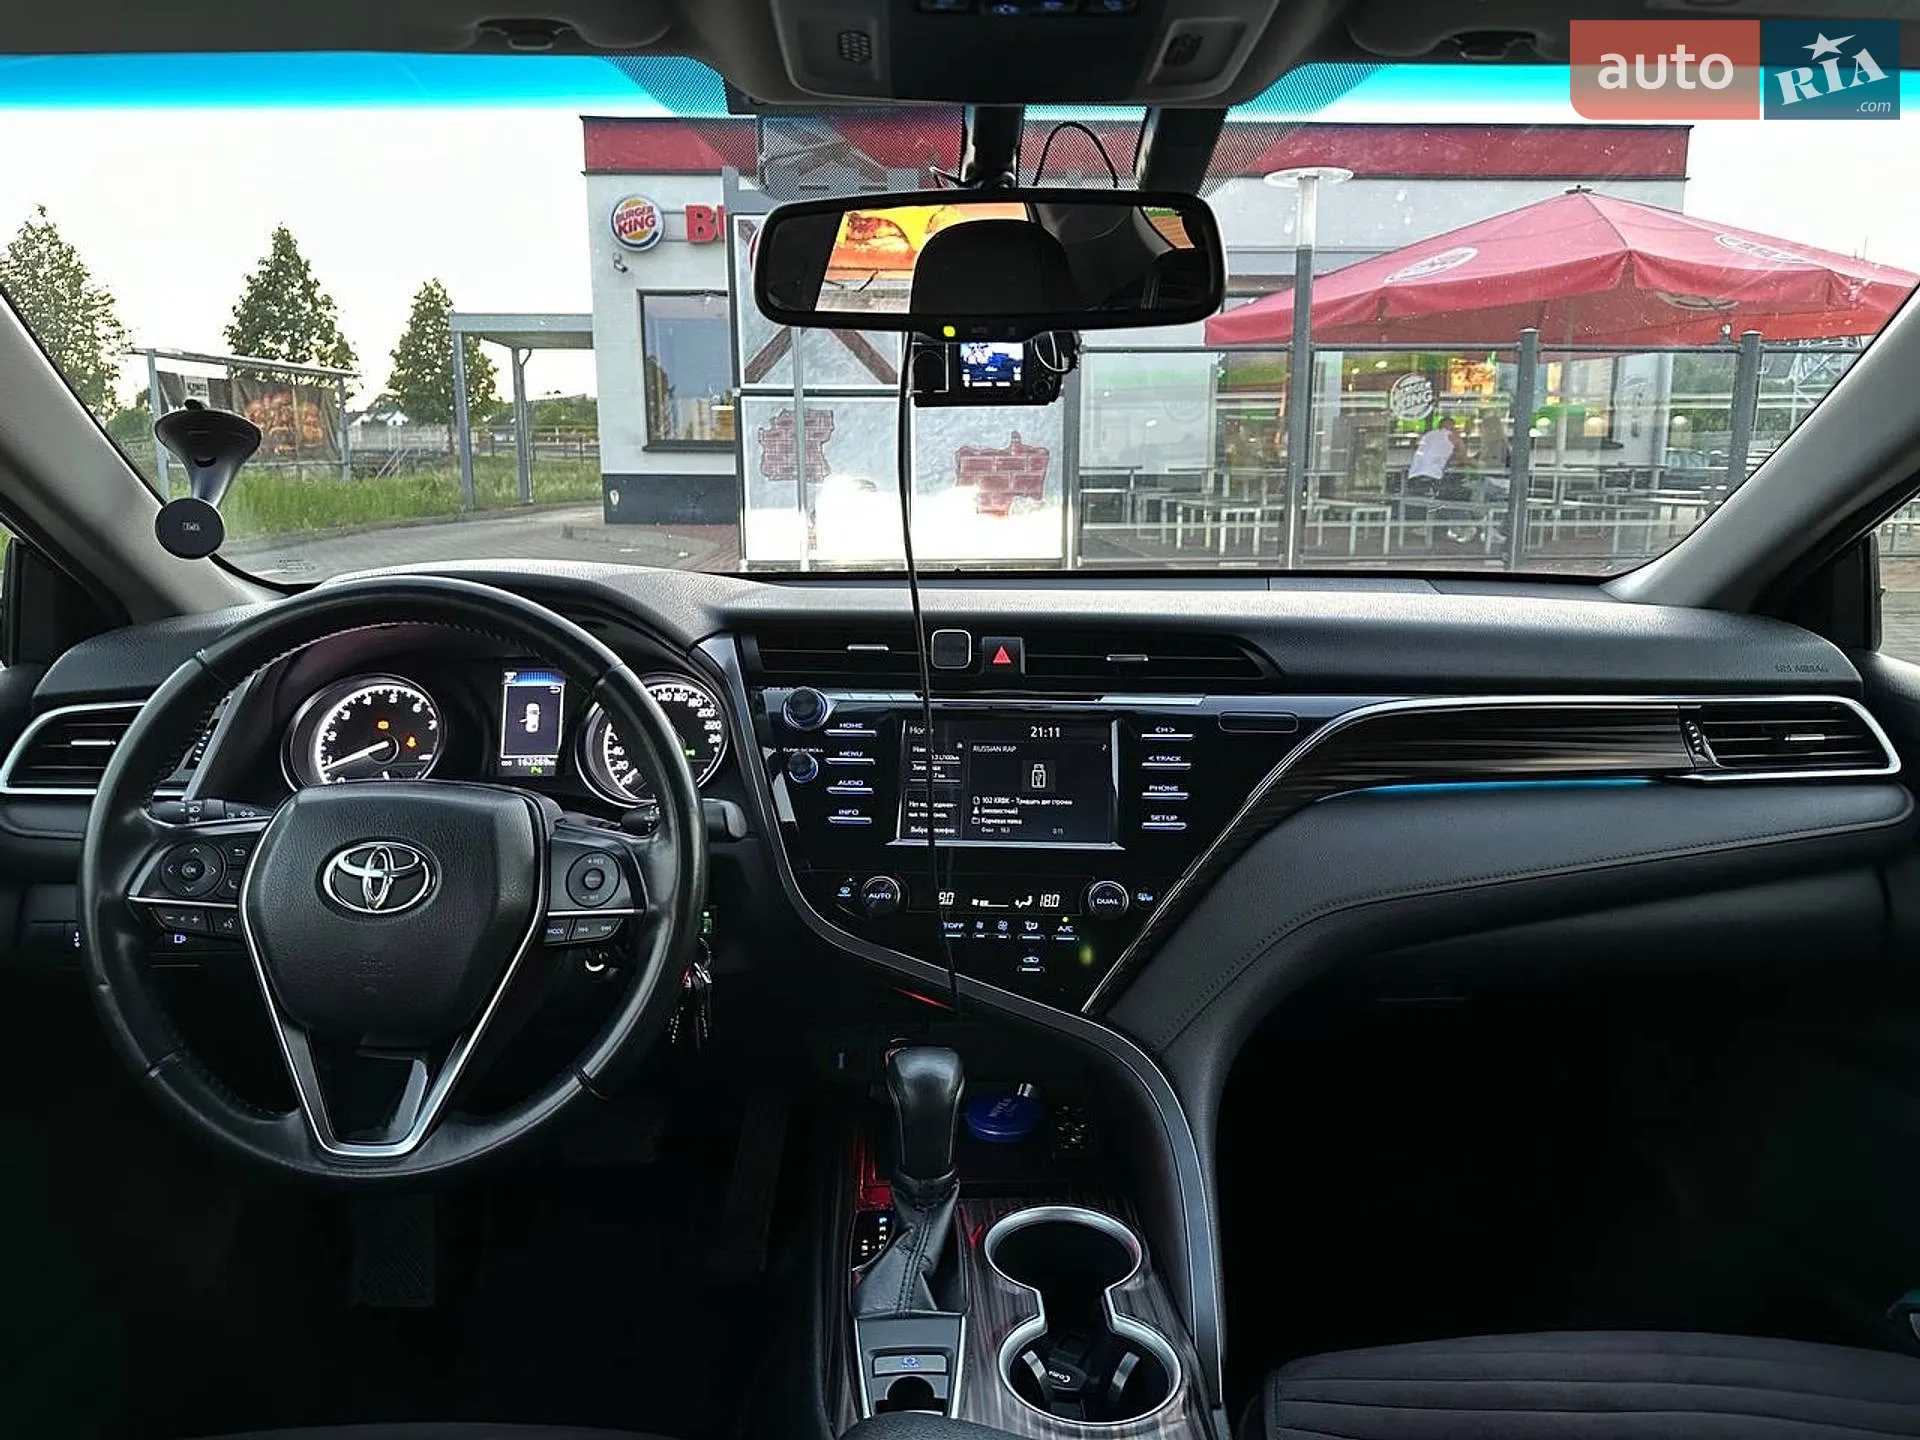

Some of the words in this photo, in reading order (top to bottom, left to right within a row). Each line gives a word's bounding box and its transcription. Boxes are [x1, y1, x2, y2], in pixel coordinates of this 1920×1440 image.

[615, 205, 655, 221] BURGER
[618, 215, 657, 237] KING
[674, 692, 689, 702] 160
[412, 703, 422, 713] 6
[697, 708, 715, 718] 200
[428, 720, 438, 730] 7
[704, 720, 722, 730] 220
[1030, 726, 1060, 738] 21:11
[972, 745, 1001, 753] RUSSIAN
[615, 760, 629, 770] 20
[868, 892, 892, 900] AUTO
[1096, 897, 1118, 905] DUAL
